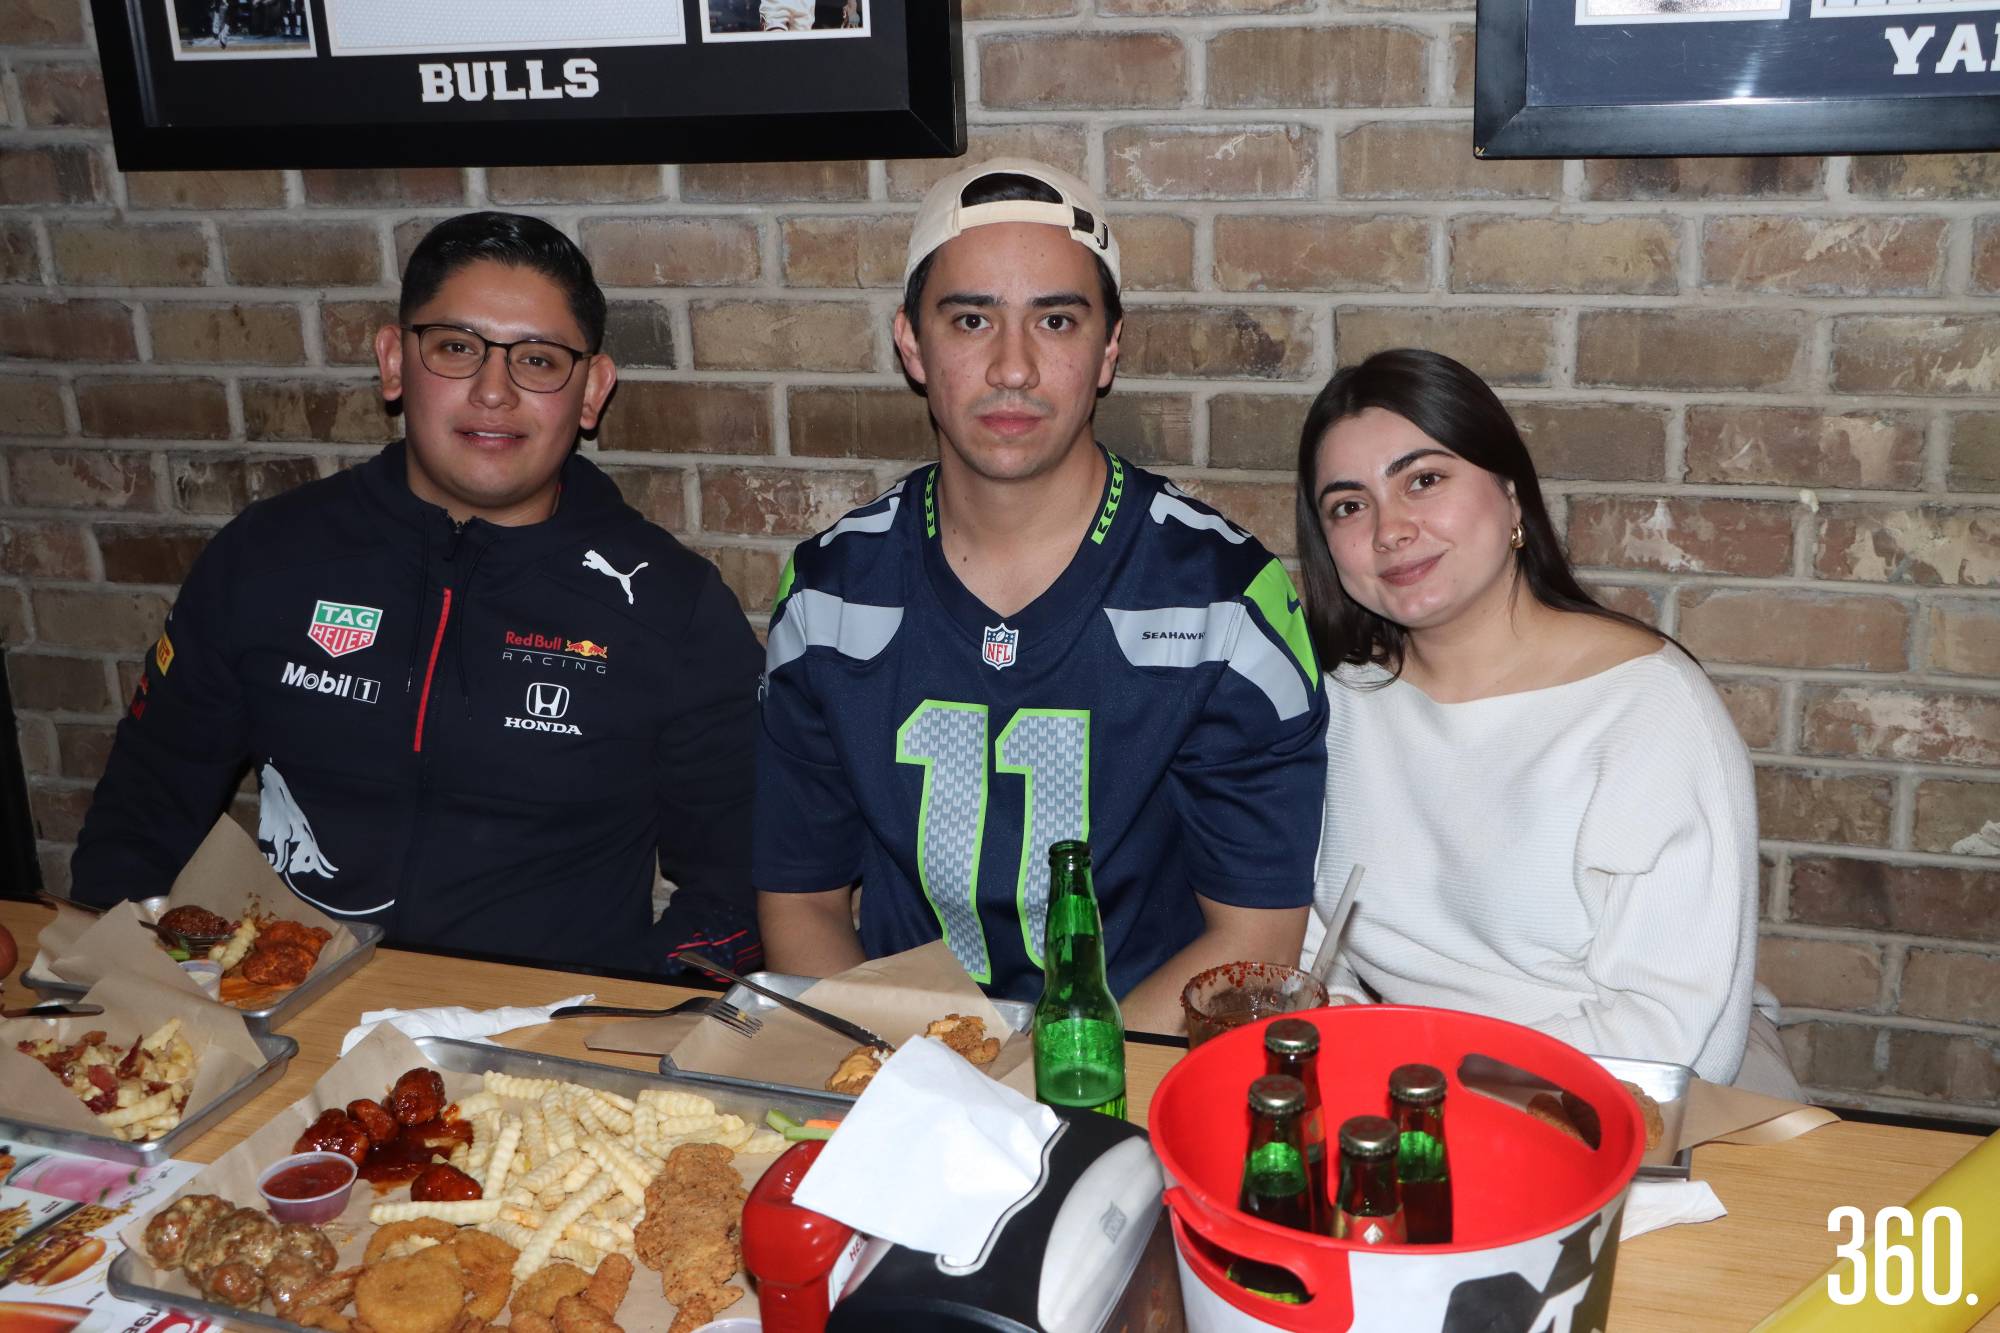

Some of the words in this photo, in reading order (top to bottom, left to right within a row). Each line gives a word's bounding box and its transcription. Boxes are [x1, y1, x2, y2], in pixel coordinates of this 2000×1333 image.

[418, 58, 600, 103] BULLS
[321, 605, 375, 628] TAG
[313, 626, 372, 653] HEUER
[505, 631, 533, 647] Red
[534, 634, 562, 651] Bull
[502, 651, 607, 675] RACING
[987, 643, 1011, 662] NFL
[281, 661, 352, 698] Mobil
[362, 681, 372, 700] 1
[504, 716, 583, 735] HONDA
[895, 698, 1091, 985] 11
